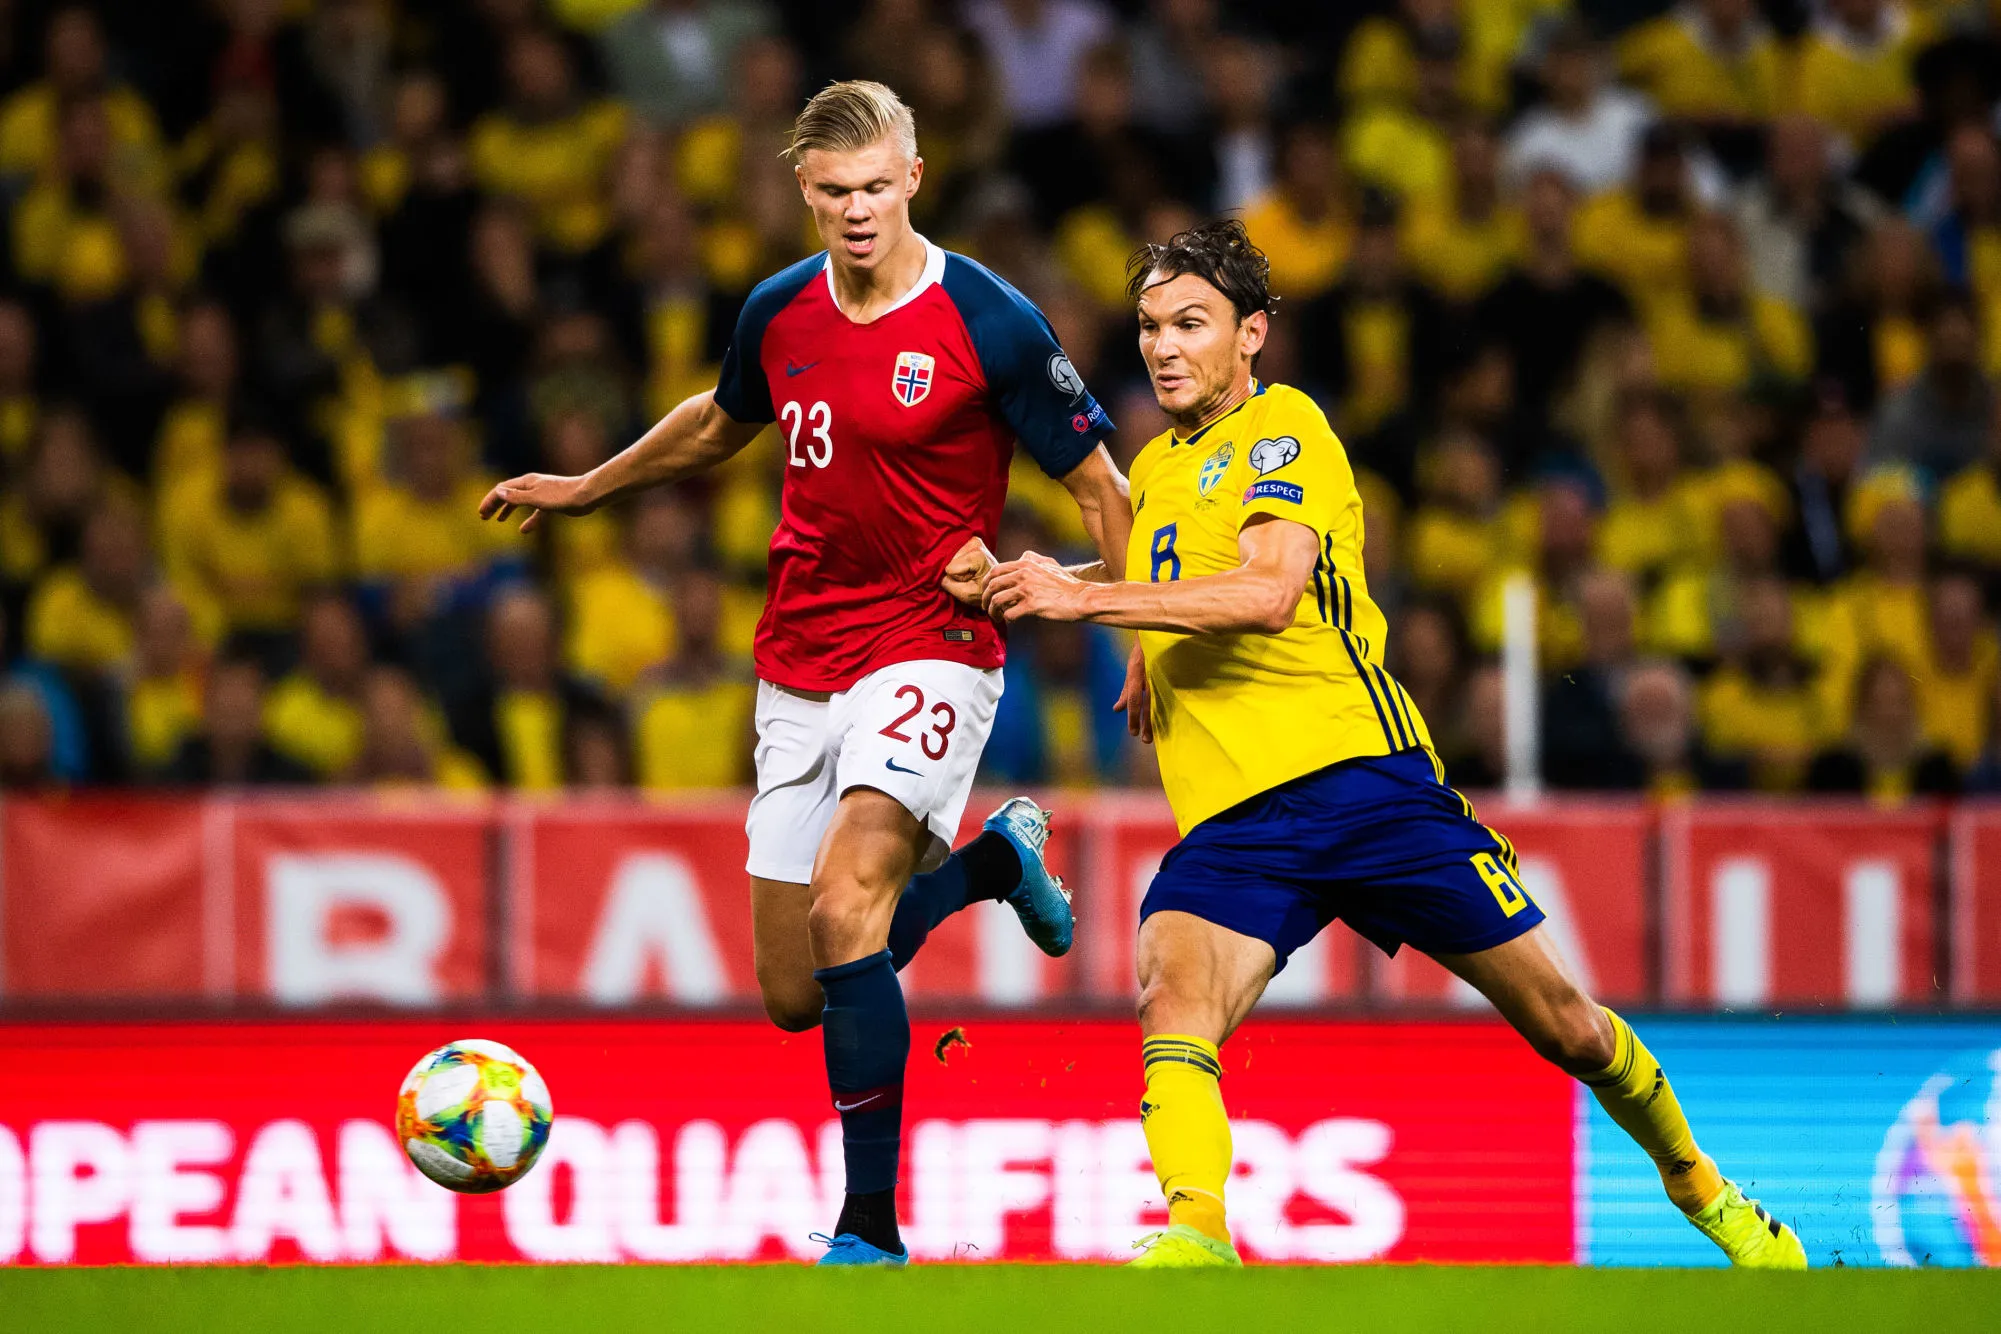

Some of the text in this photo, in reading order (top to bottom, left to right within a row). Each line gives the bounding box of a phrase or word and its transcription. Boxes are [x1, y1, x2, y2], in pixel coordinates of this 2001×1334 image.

[780, 400, 833, 469] 23
[1255, 484, 1303, 500] RESPECT
[877, 684, 956, 761] 23
[1469, 852, 1528, 918] 8
